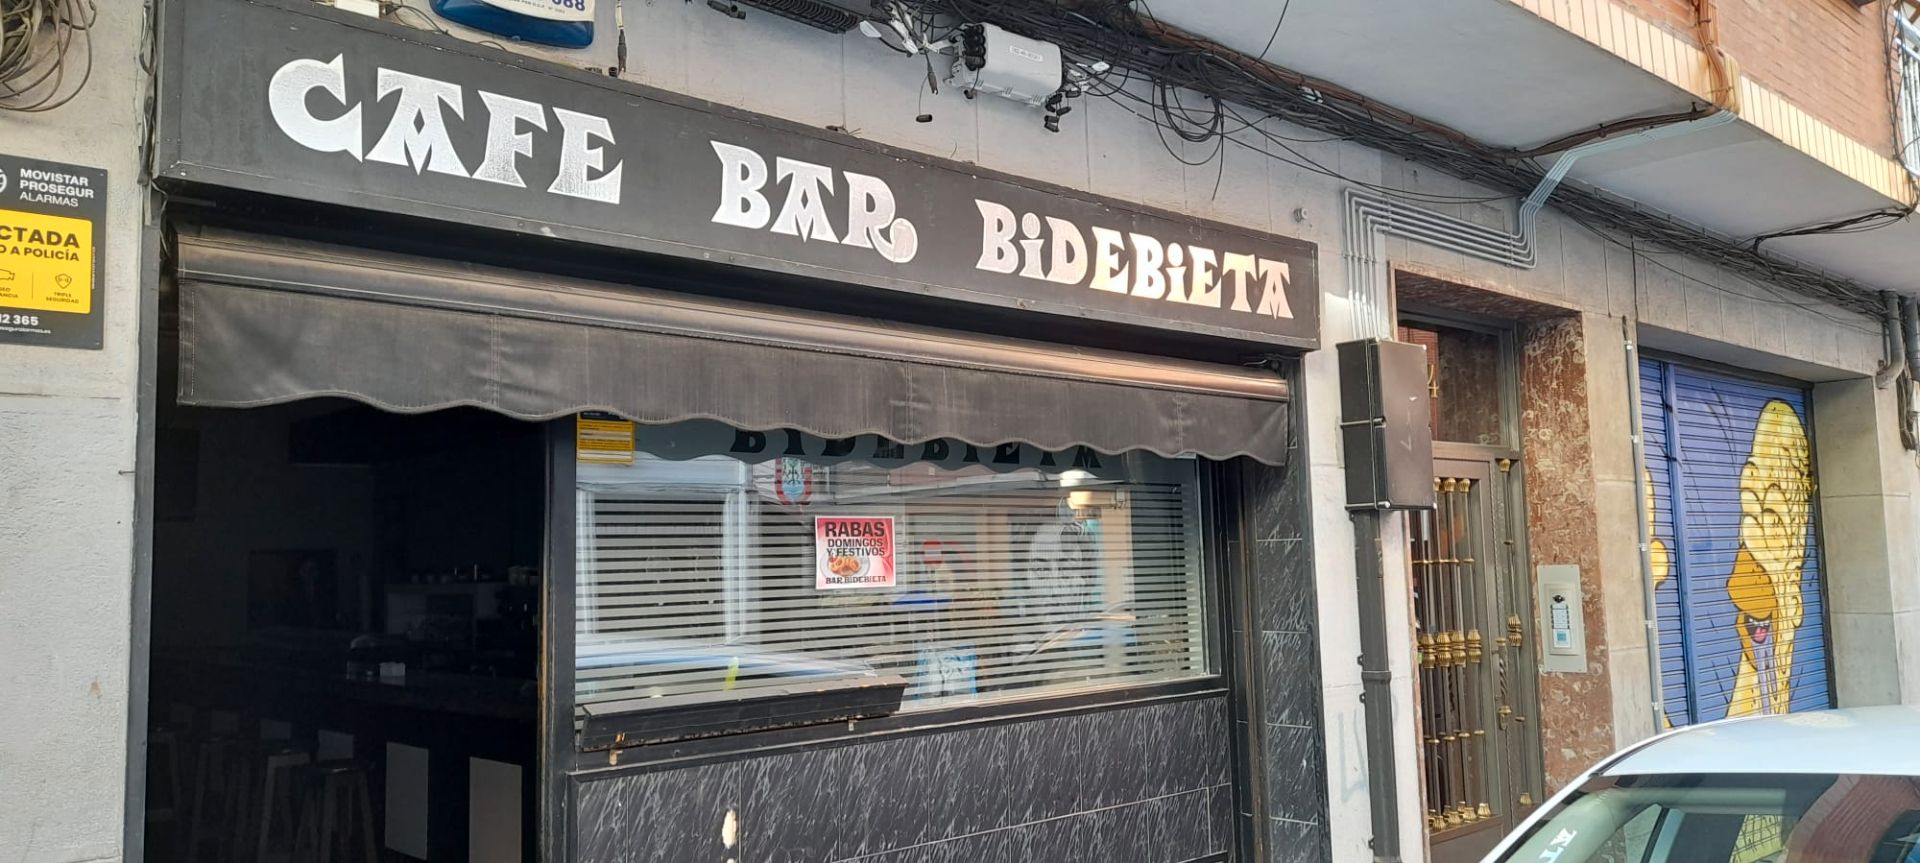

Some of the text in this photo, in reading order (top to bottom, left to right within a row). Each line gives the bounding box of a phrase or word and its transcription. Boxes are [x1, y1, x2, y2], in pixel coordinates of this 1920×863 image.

[268, 52, 624, 205] CAFE
[710, 139, 918, 263] BAR
[20, 168, 89, 187] MOVISTAR
[20, 180, 95, 199] PROSEGUR
[20, 191, 79, 208] ALARMAS
[10, 246, 20, 256] A
[24, 247, 80, 262] POLICÍA
[13, 314, 39, 326] 365
[825, 521, 885, 537] RABAS
[827, 538, 884, 548] DOMINGOS
[826, 547, 885, 557] Y FESTIVOS
[825, 576, 843, 585] BAR
